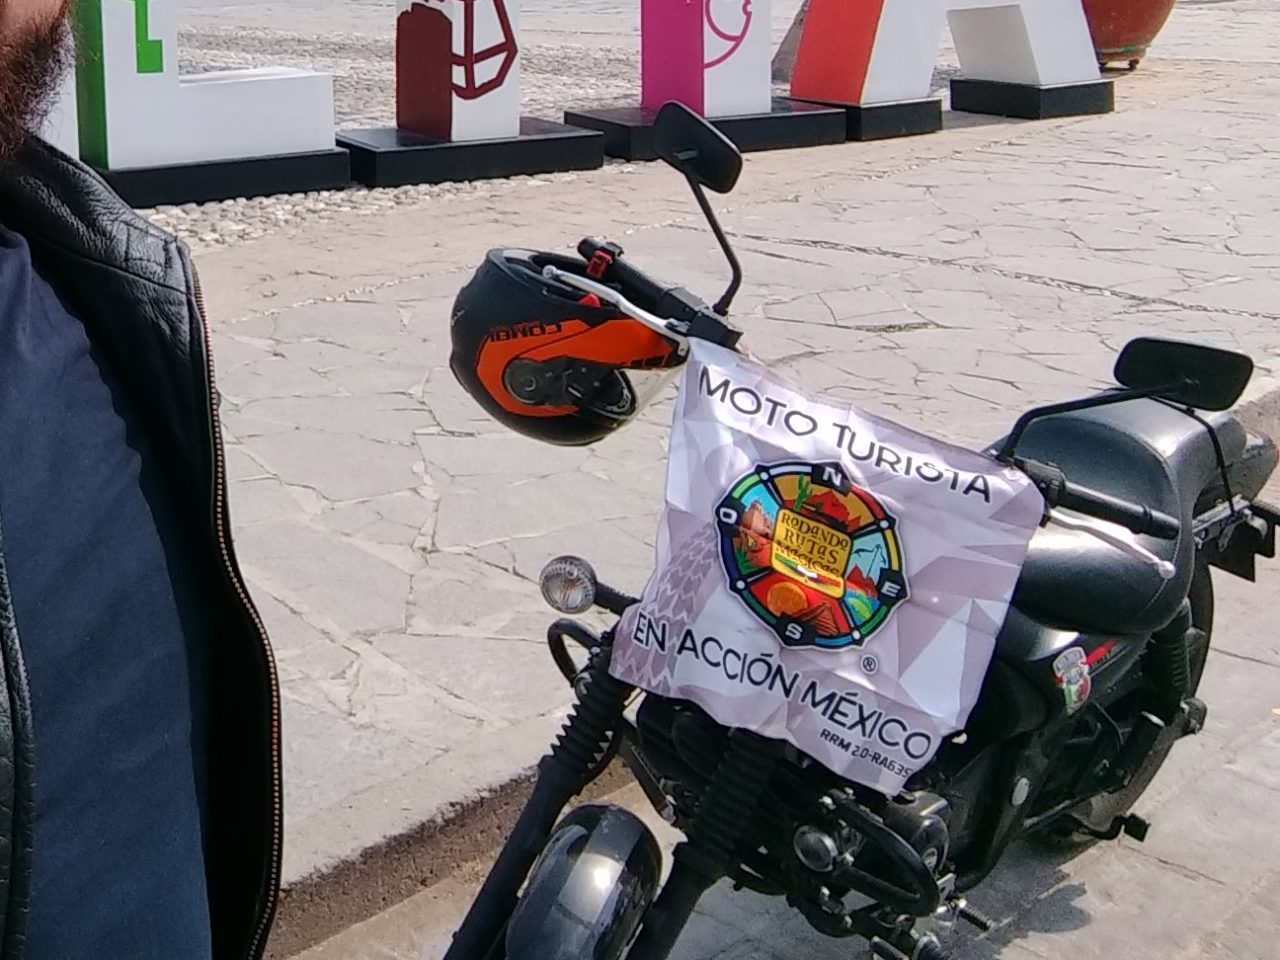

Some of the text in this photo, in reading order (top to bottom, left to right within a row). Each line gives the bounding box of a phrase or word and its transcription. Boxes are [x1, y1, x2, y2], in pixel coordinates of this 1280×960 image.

[699, 365, 990, 503] MOTO TURISTA
[633, 612, 932, 760] EN ACCIÓN MÉXICO
[820, 729, 852, 753] RRM
